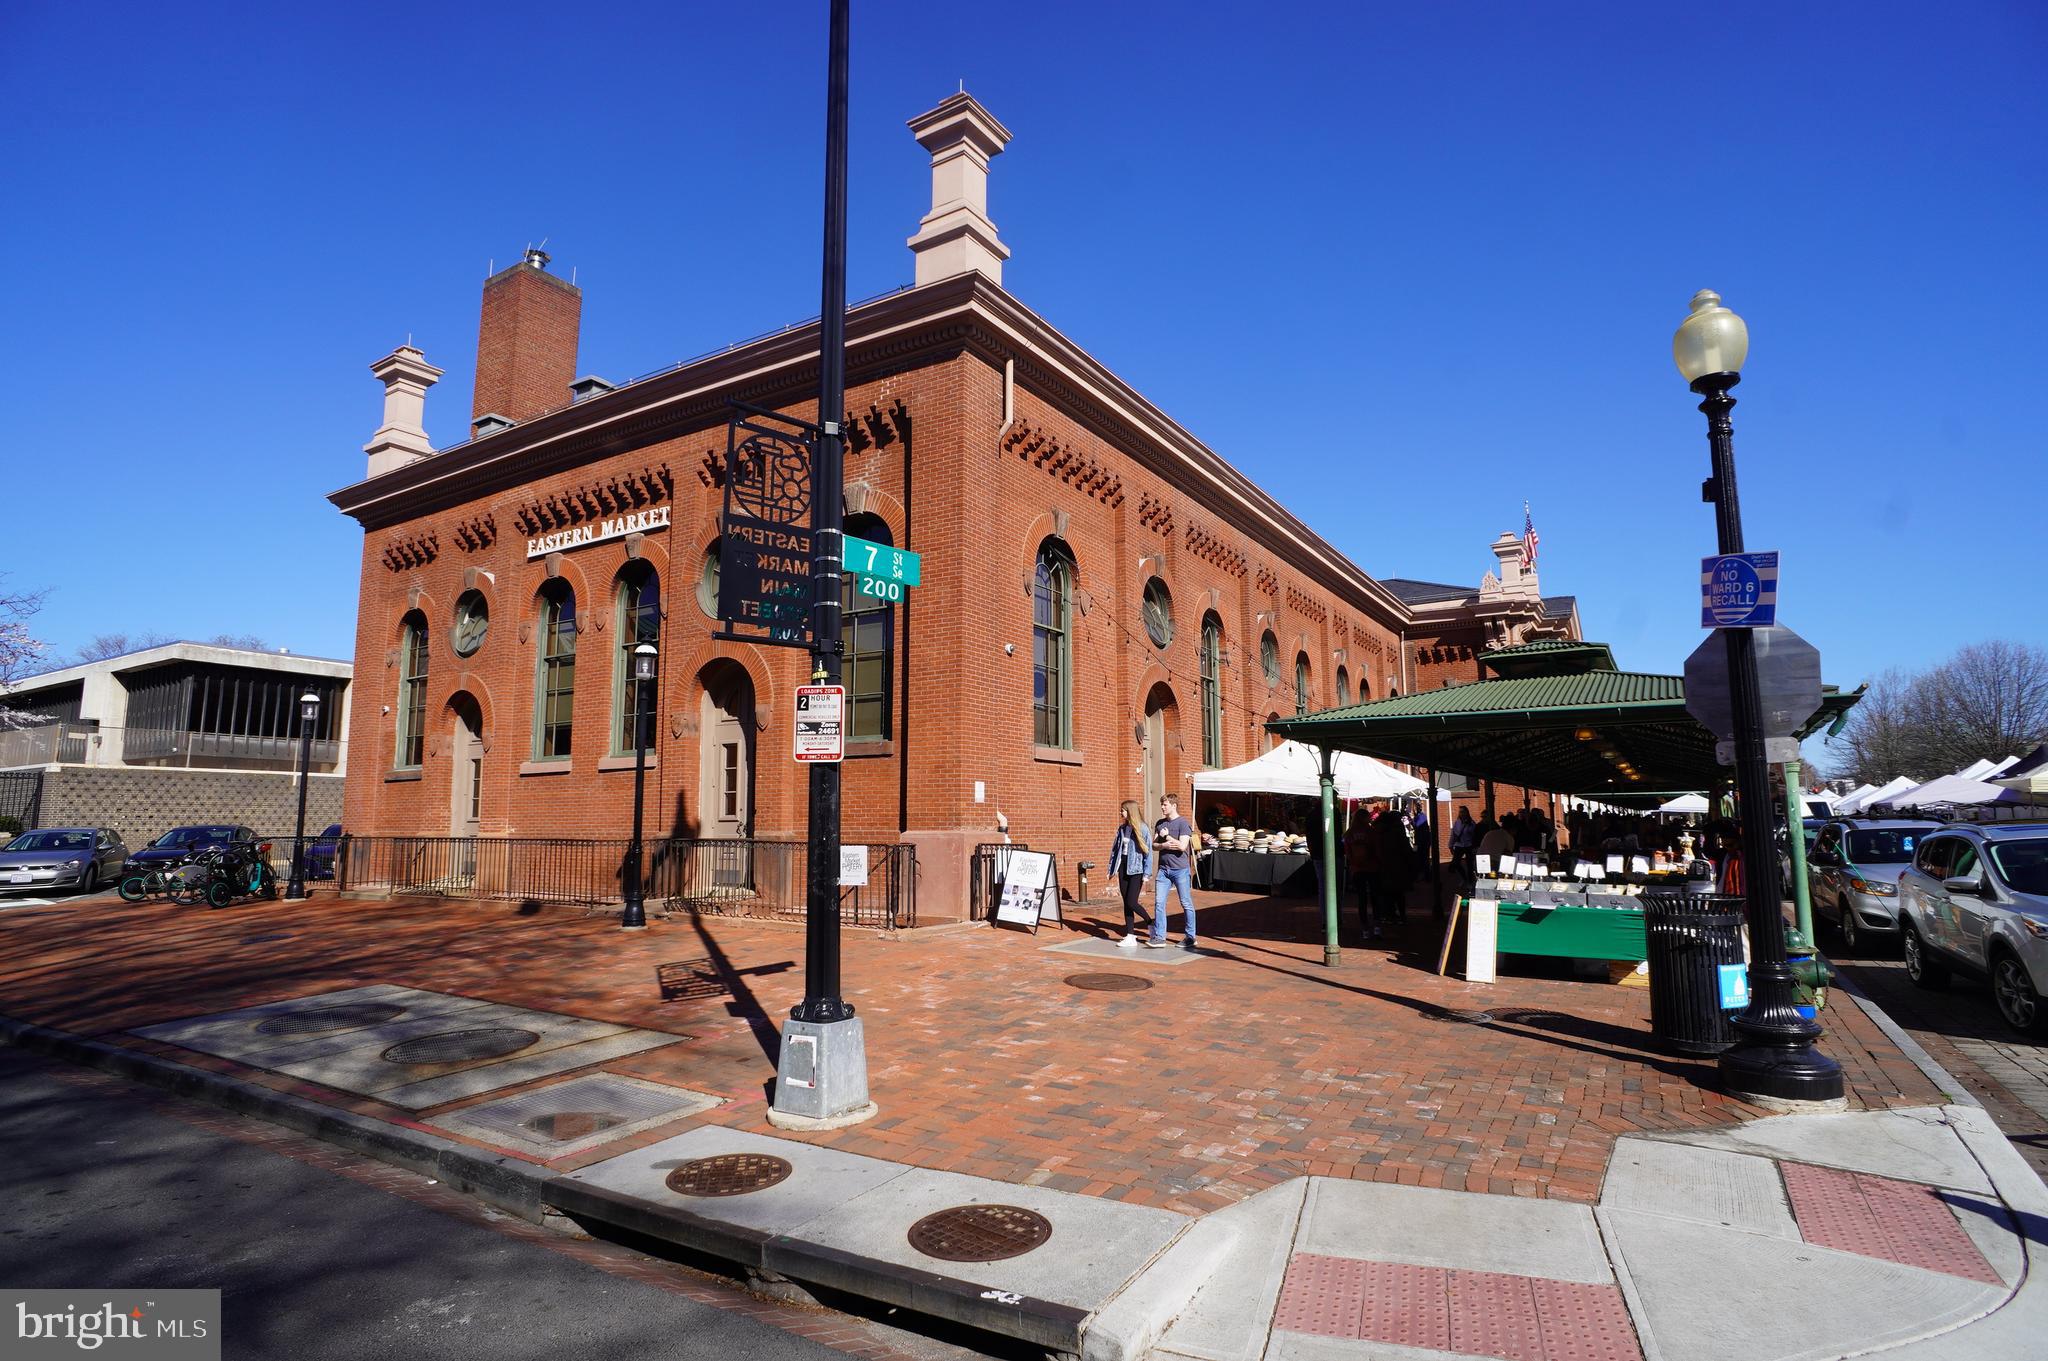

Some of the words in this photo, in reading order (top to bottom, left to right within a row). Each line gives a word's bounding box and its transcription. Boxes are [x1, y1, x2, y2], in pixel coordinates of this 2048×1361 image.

[527, 525, 594, 553] EASTERN
[601, 506, 670, 537] MARKET
[865, 545, 878, 571] 7
[893, 552, 903, 566] St
[893, 565, 903, 579] Se
[1721, 570, 1738, 581] NO
[863, 577, 899, 600] 200
[1712, 582, 1742, 594] WARD
[1746, 582, 1754, 592] 6
[1712, 594, 1754, 606] RECALL
[800, 697, 807, 709] 2
